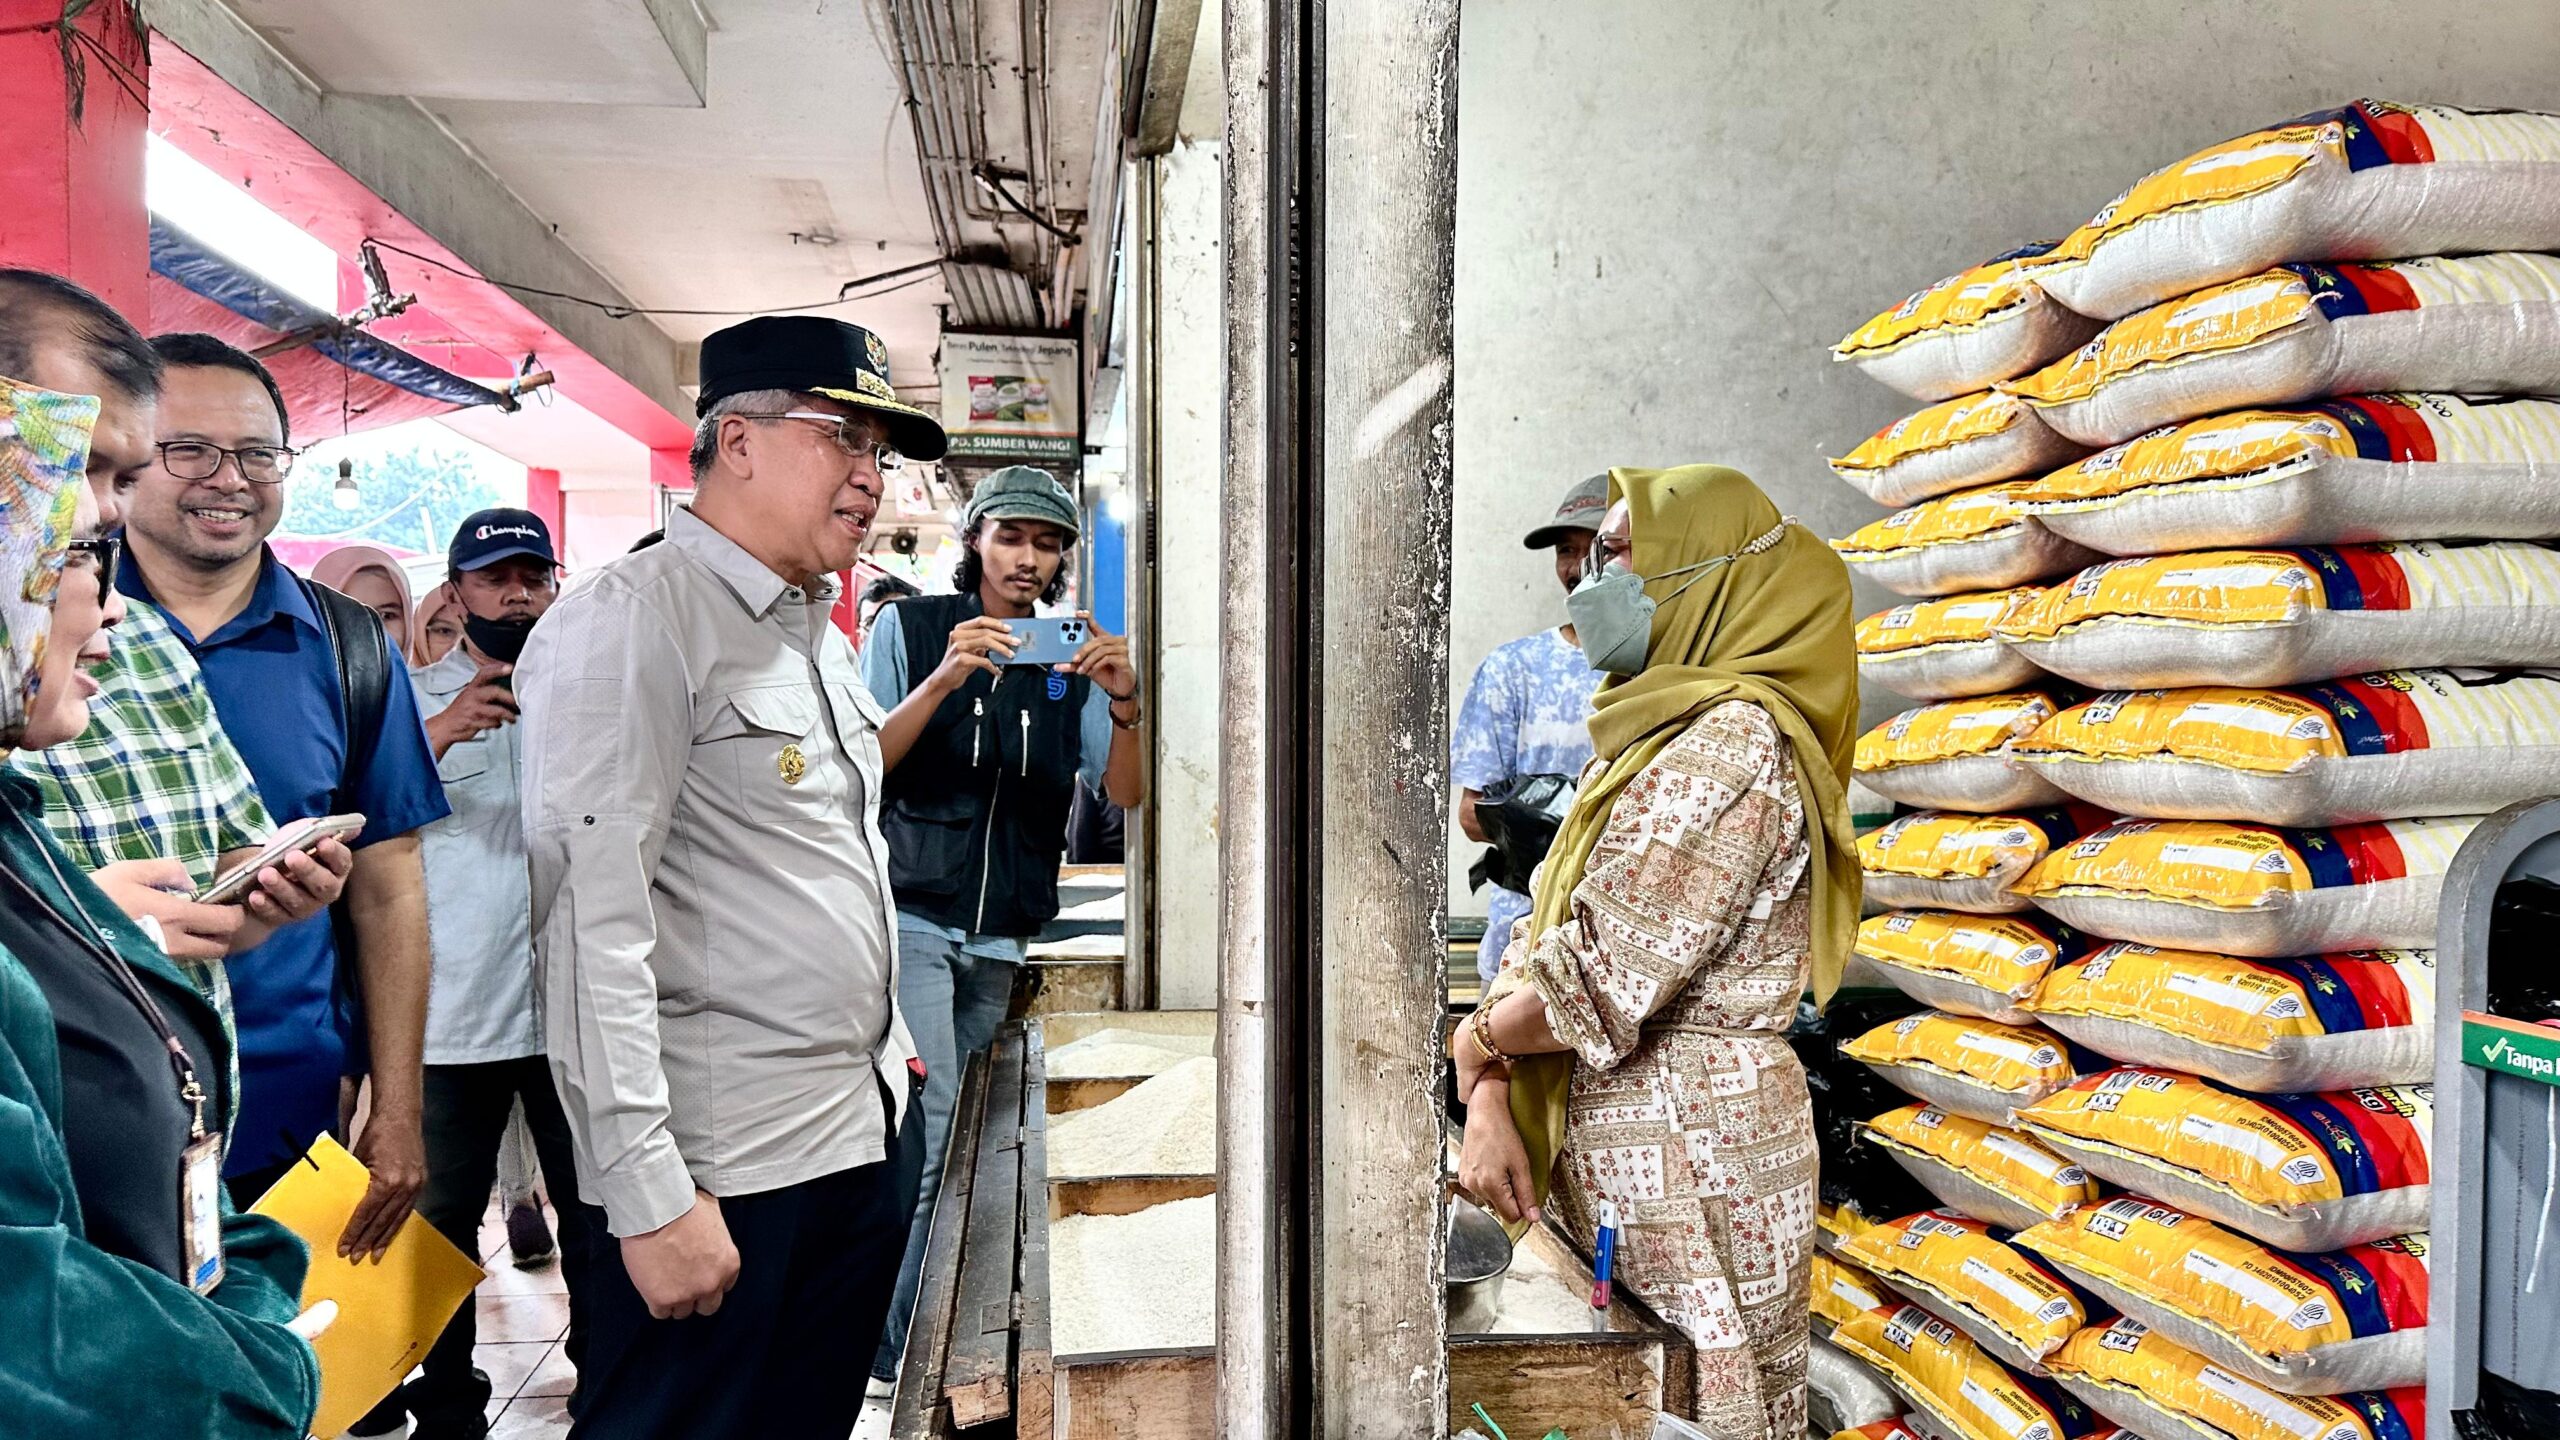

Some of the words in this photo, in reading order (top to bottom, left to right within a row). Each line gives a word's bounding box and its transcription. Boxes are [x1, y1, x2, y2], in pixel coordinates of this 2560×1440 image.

[1038, 345, 1072, 356] Jepang
[973, 438, 1026, 449] SUMBER
[1027, 440, 1071, 450] WANGI
[475, 525, 540, 540] Champion
[2504, 1046, 2552, 1075] Tanpa
